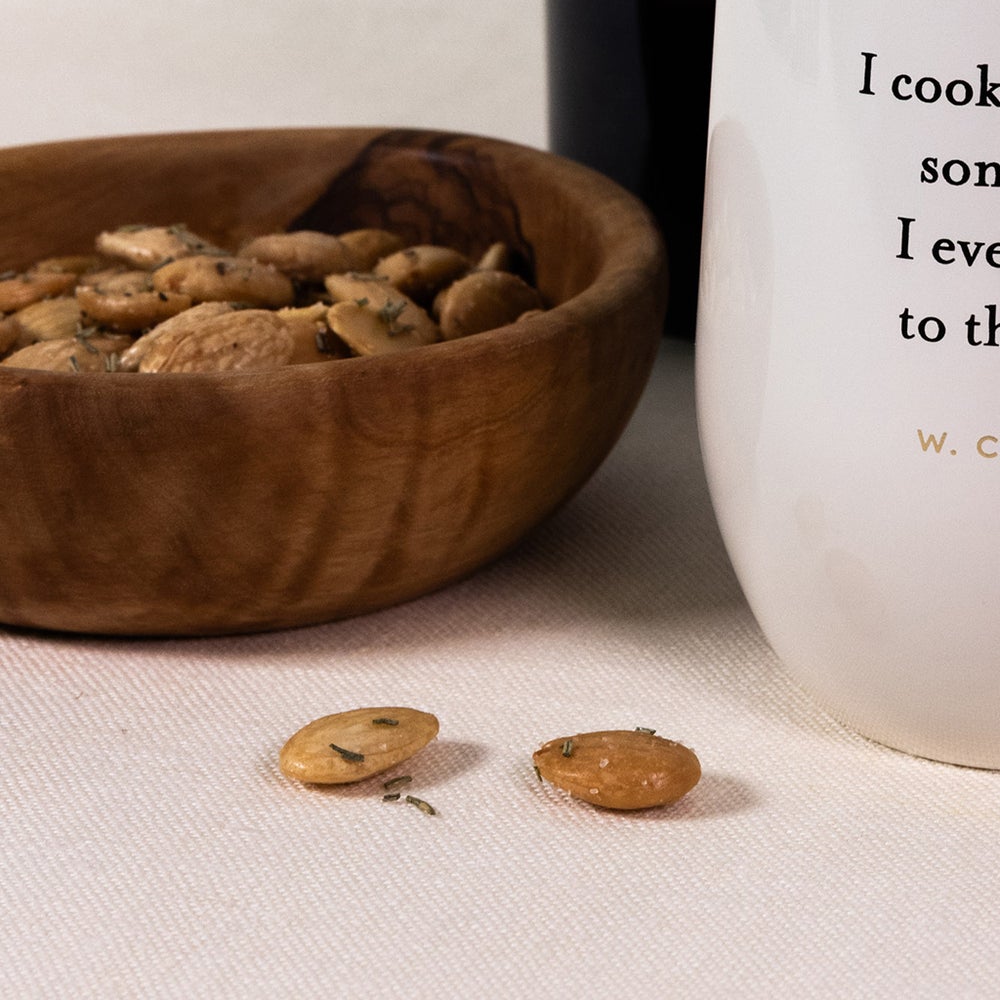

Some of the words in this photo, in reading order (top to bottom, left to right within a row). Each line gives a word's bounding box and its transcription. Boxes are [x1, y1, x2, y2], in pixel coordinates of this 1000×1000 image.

[858, 51, 879, 96] I
[895, 216, 917, 261] I
[898, 307, 948, 344] to
[916, 428, 958, 457] W.
